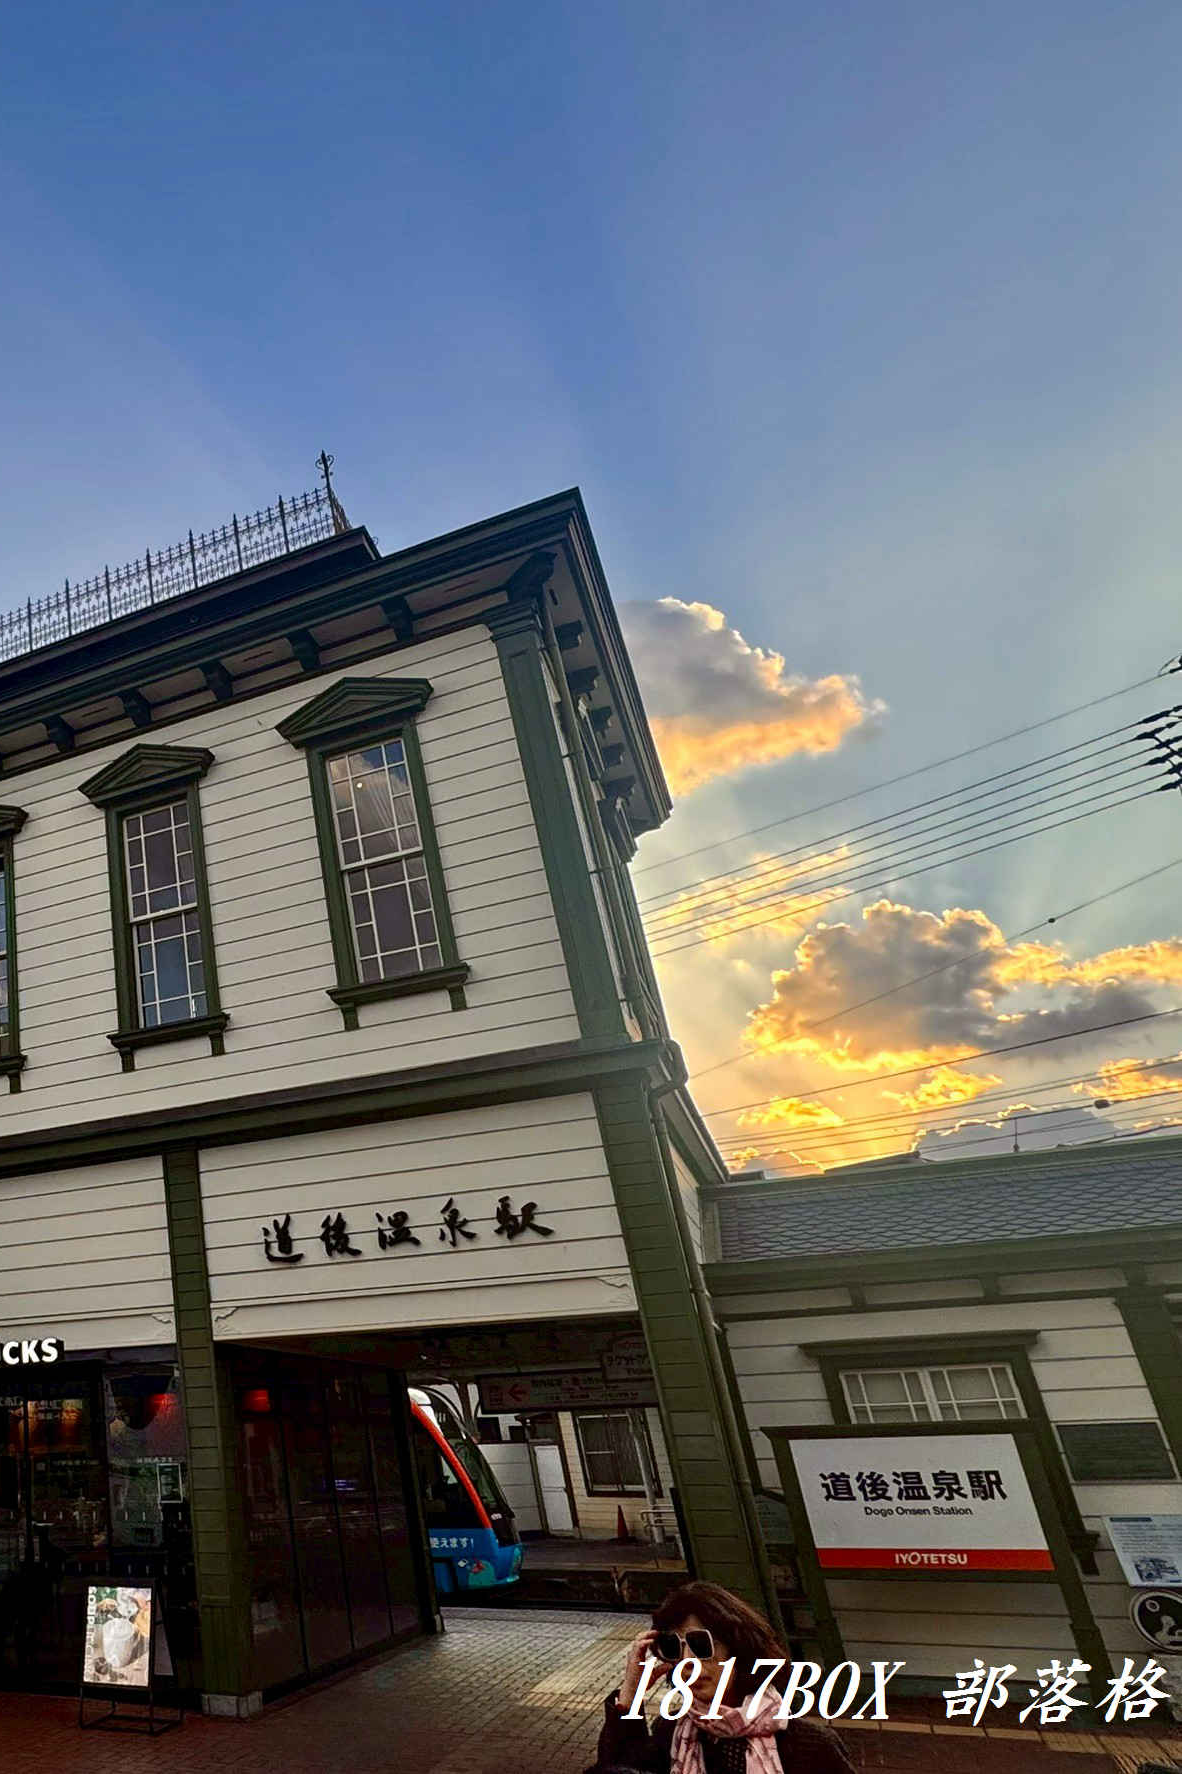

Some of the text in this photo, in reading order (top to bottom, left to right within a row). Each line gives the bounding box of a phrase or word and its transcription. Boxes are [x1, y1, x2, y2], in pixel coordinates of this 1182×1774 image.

[819, 1470, 1008, 1502] 道後温泉駅
[864, 1506, 974, 1518] Dogo Onsen Station
[894, 1552, 968, 1565] IYOTETSU
